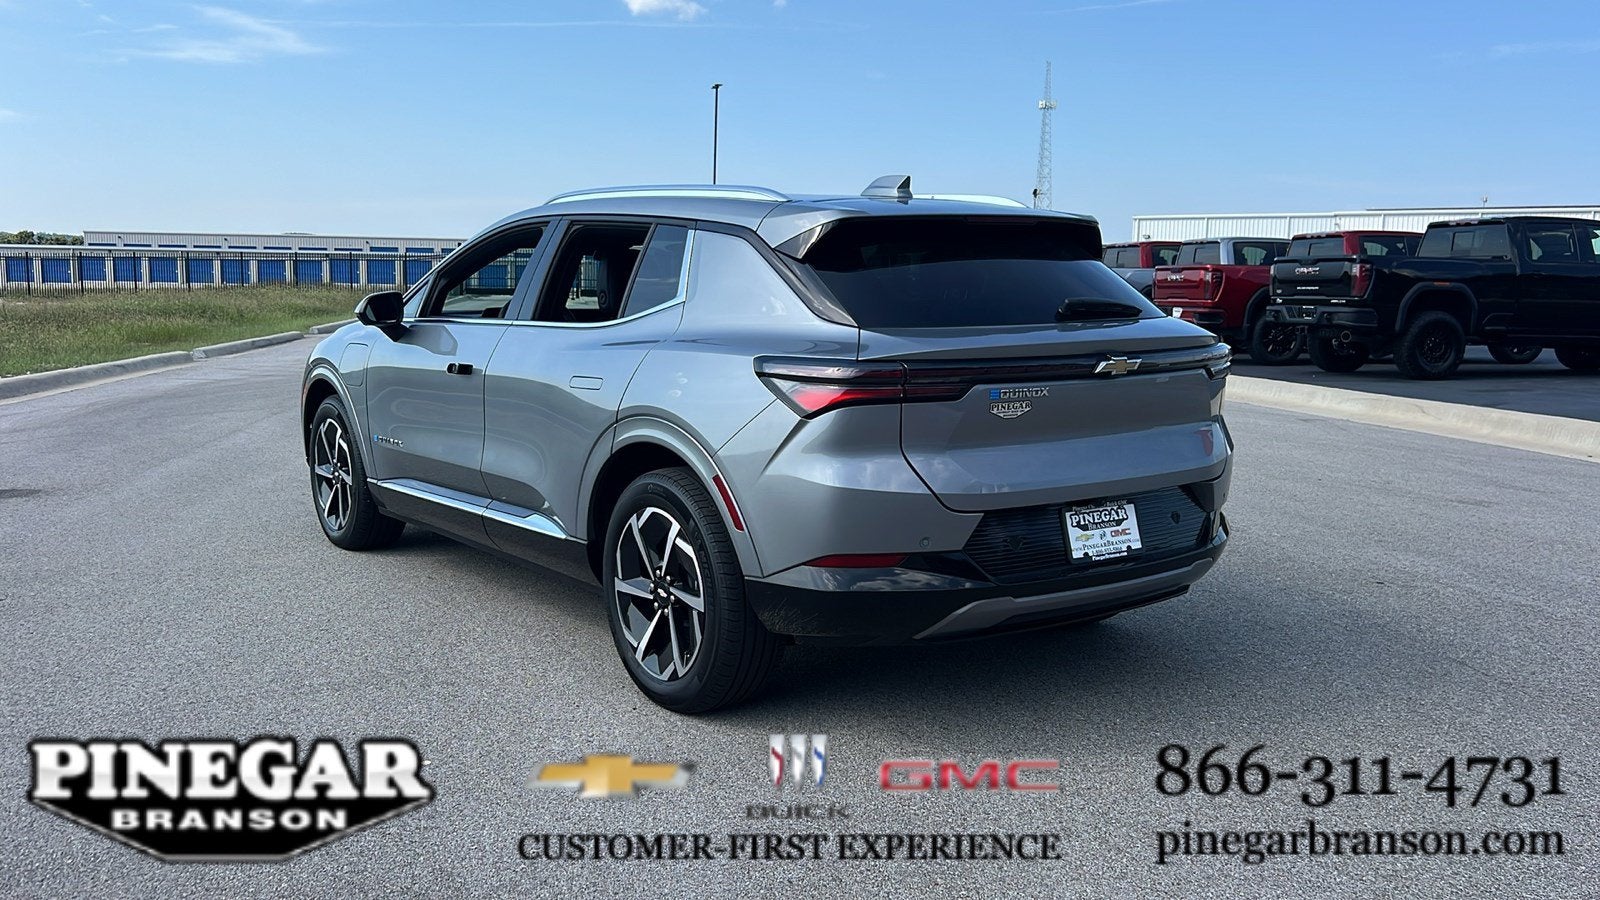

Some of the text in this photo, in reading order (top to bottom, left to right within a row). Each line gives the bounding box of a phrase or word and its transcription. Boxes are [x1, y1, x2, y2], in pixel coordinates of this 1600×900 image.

[989, 387, 1050, 399] EQUINOX
[990, 401, 1032, 411] PINEGAR
[1071, 507, 1128, 526] PINEGAR
[1088, 520, 1117, 531] BRANSON
[1110, 528, 1131, 538] GMC
